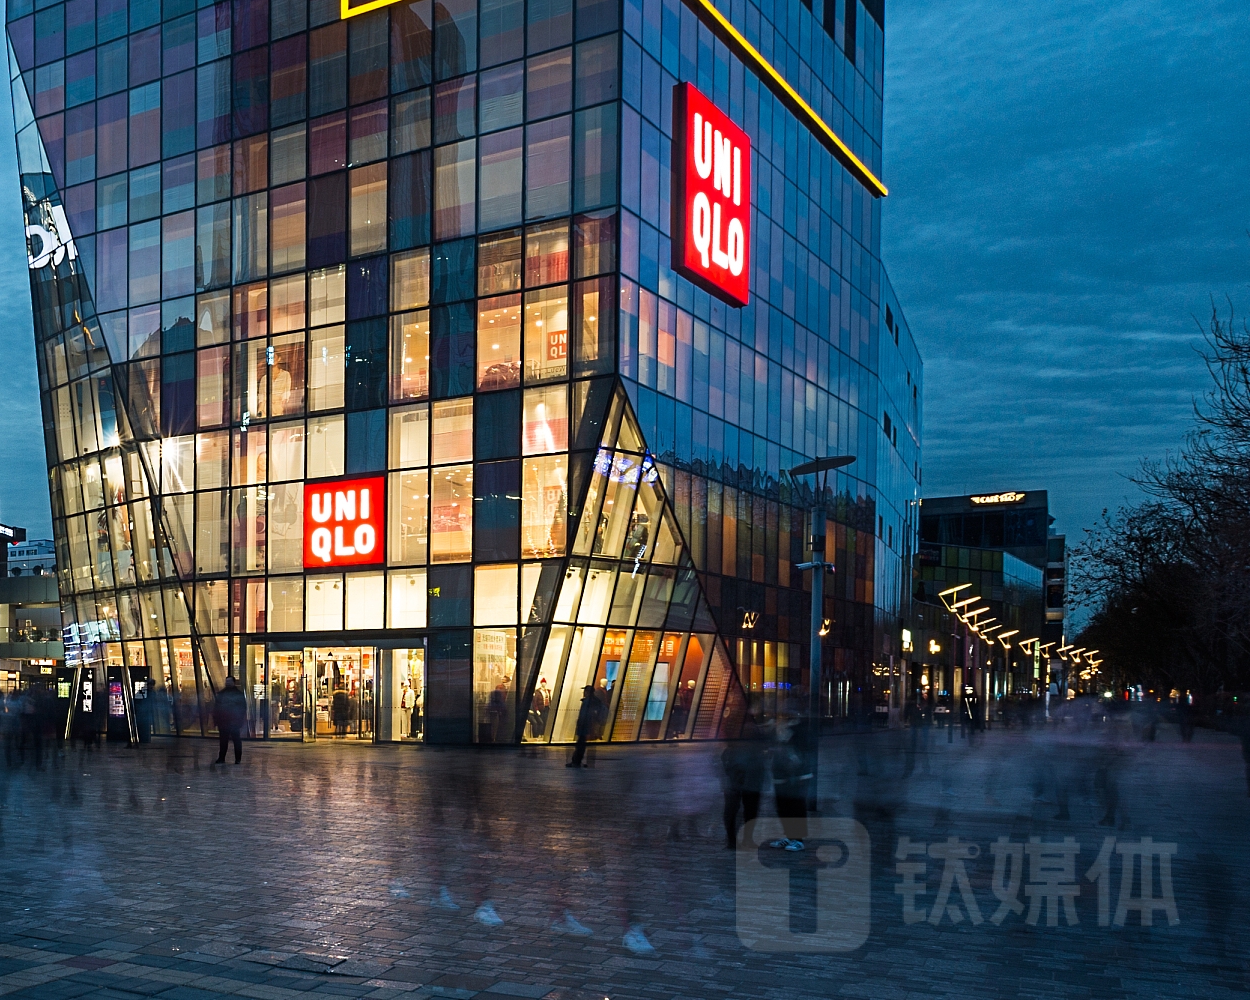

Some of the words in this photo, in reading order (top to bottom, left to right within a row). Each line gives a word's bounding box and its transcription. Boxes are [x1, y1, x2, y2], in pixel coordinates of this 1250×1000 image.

[693, 112, 741, 206] UNI
[692, 191, 744, 277] QLO
[550, 333, 567, 346] UN
[550, 345, 567, 359] QL
[311, 488, 370, 523] UNI
[311, 523, 376, 563] QLO
